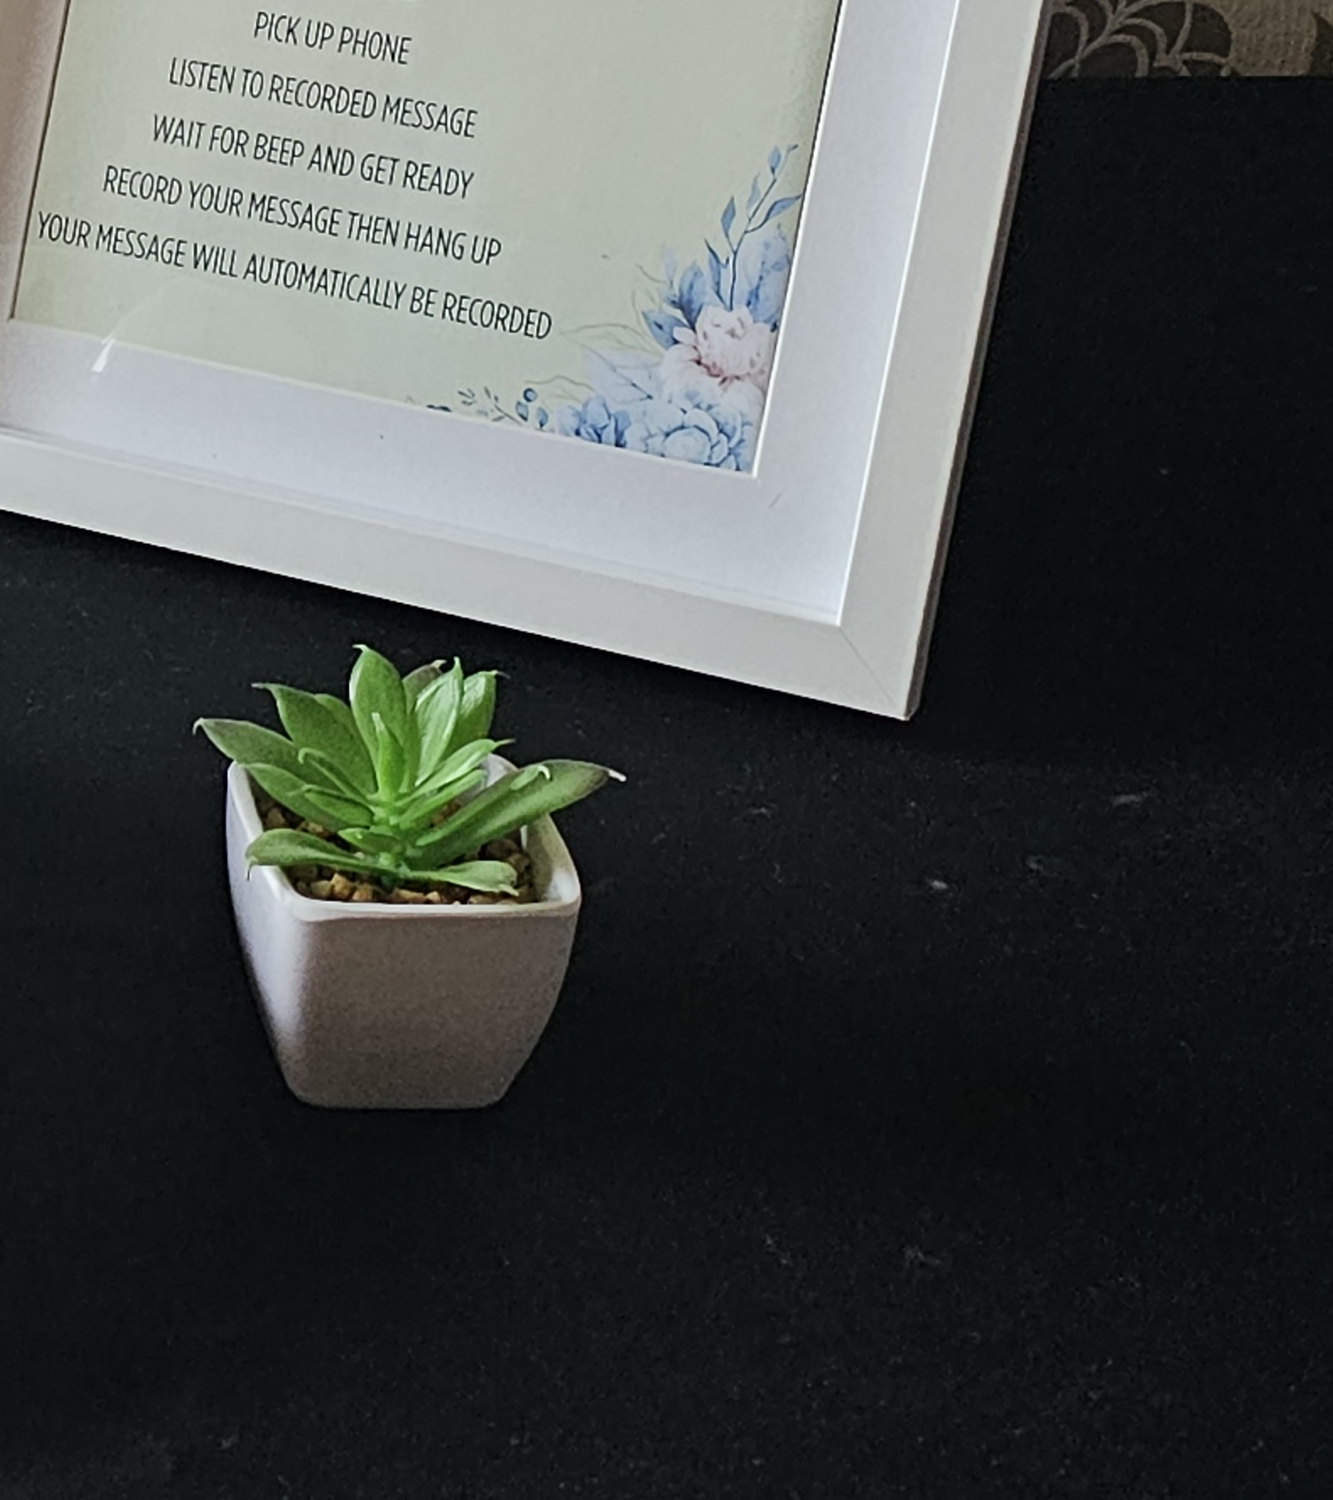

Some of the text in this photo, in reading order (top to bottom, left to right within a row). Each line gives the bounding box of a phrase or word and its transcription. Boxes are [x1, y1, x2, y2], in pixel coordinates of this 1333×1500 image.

[254, 11, 412, 65] PICK UP PHONE
[169, 57, 478, 139] LISTEN TO RECORDED MESSAGE
[153, 113, 475, 200] WAIT FOR BEEP AND GET READY
[103, 164, 502, 266] RECORD YOUR MESSAGE THEN HANG UP
[38, 210, 553, 340] YOUR MESSAGE WILL AUTOMATICALLY BE RECORDED
